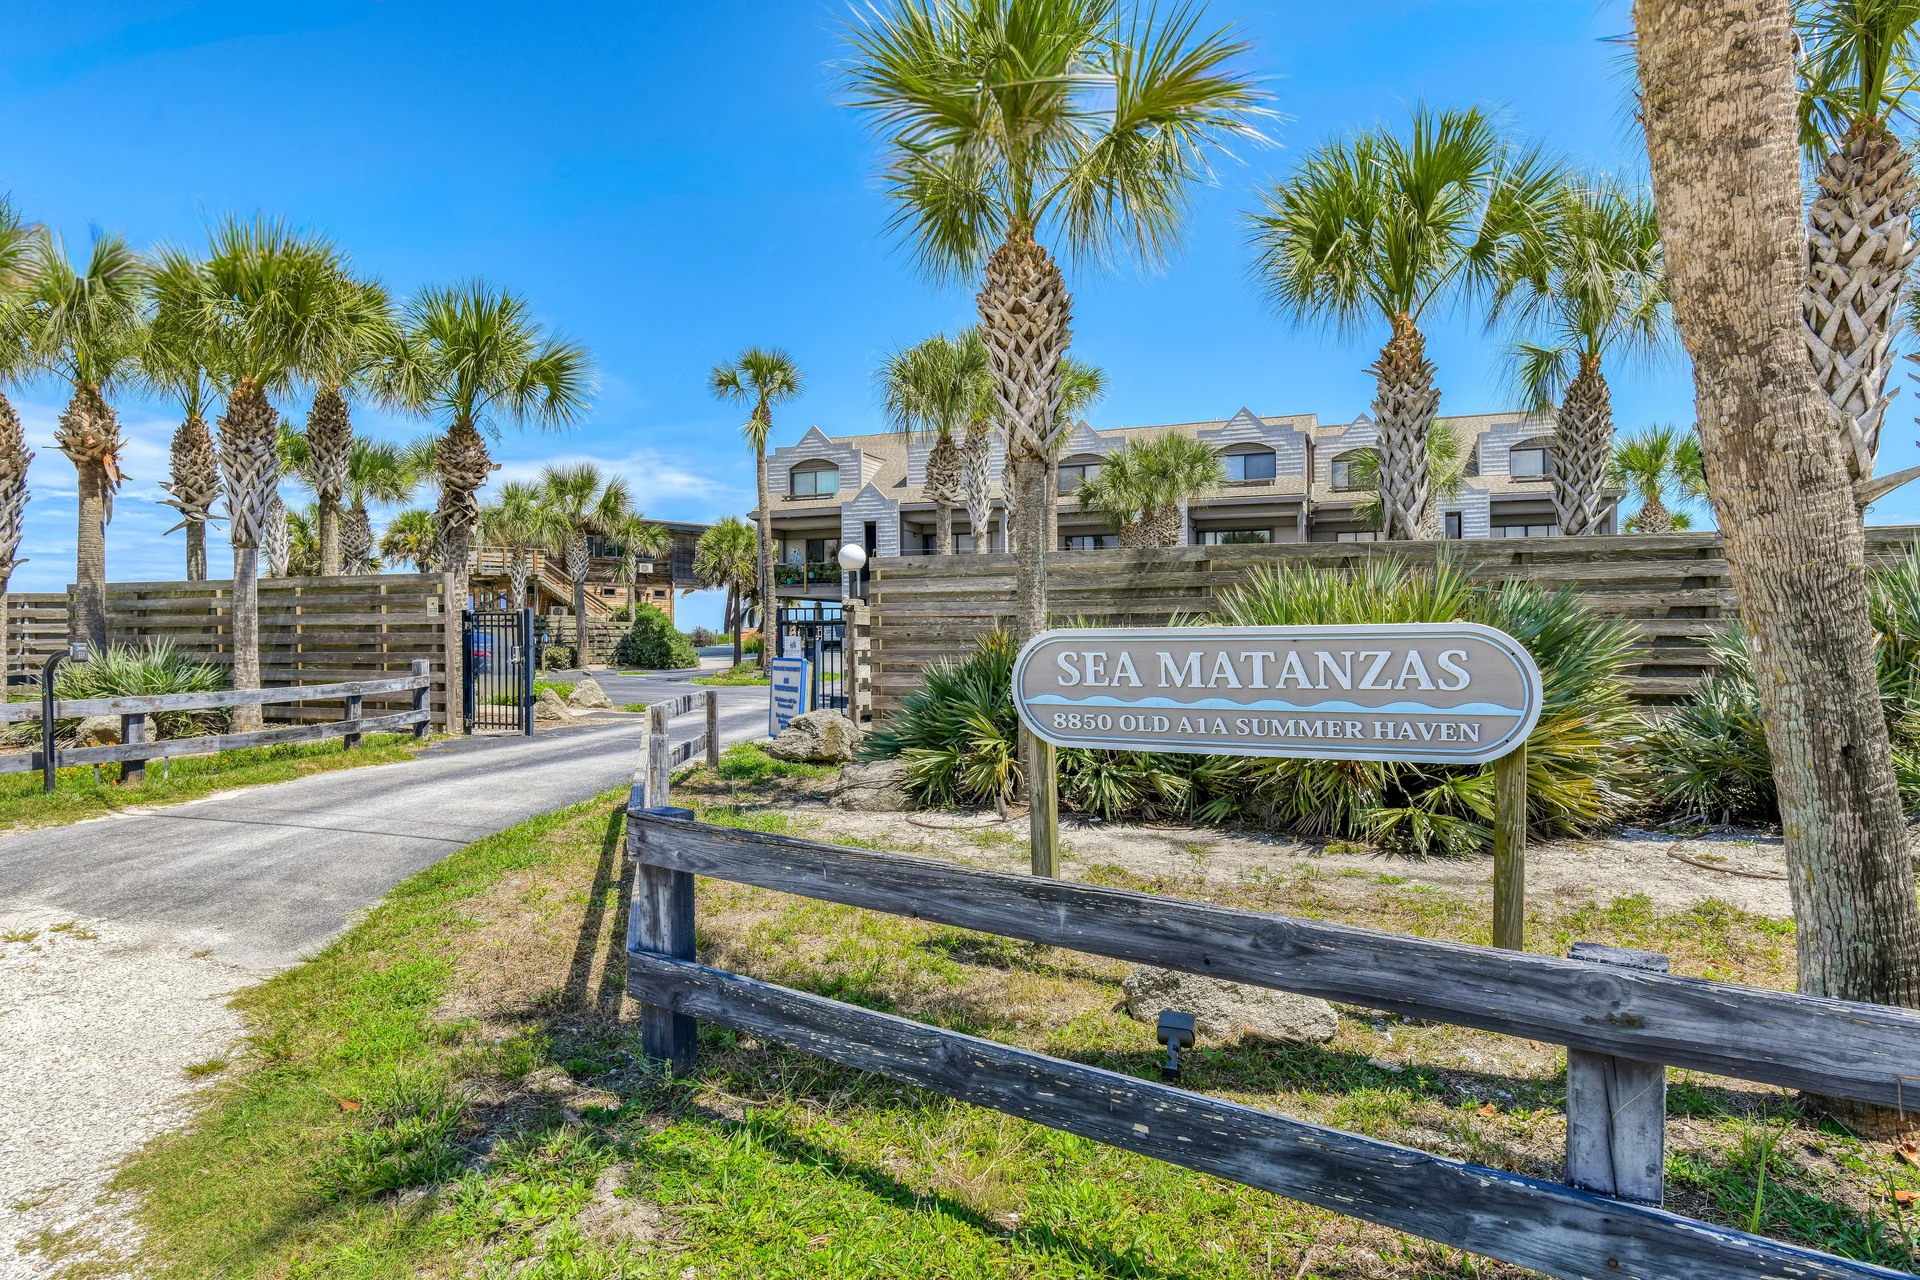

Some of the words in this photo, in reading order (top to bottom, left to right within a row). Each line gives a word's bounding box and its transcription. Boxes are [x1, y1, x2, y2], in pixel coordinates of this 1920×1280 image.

[1056, 651, 1144, 687] SEA
[1156, 649, 1471, 691] MATANZAS
[1053, 712, 1113, 731] 8850
[1118, 714, 1170, 732] OLD
[1176, 716, 1229, 735] A1A
[1235, 718, 1365, 739] SUMMER
[1372, 721, 1480, 742] HAVEN
